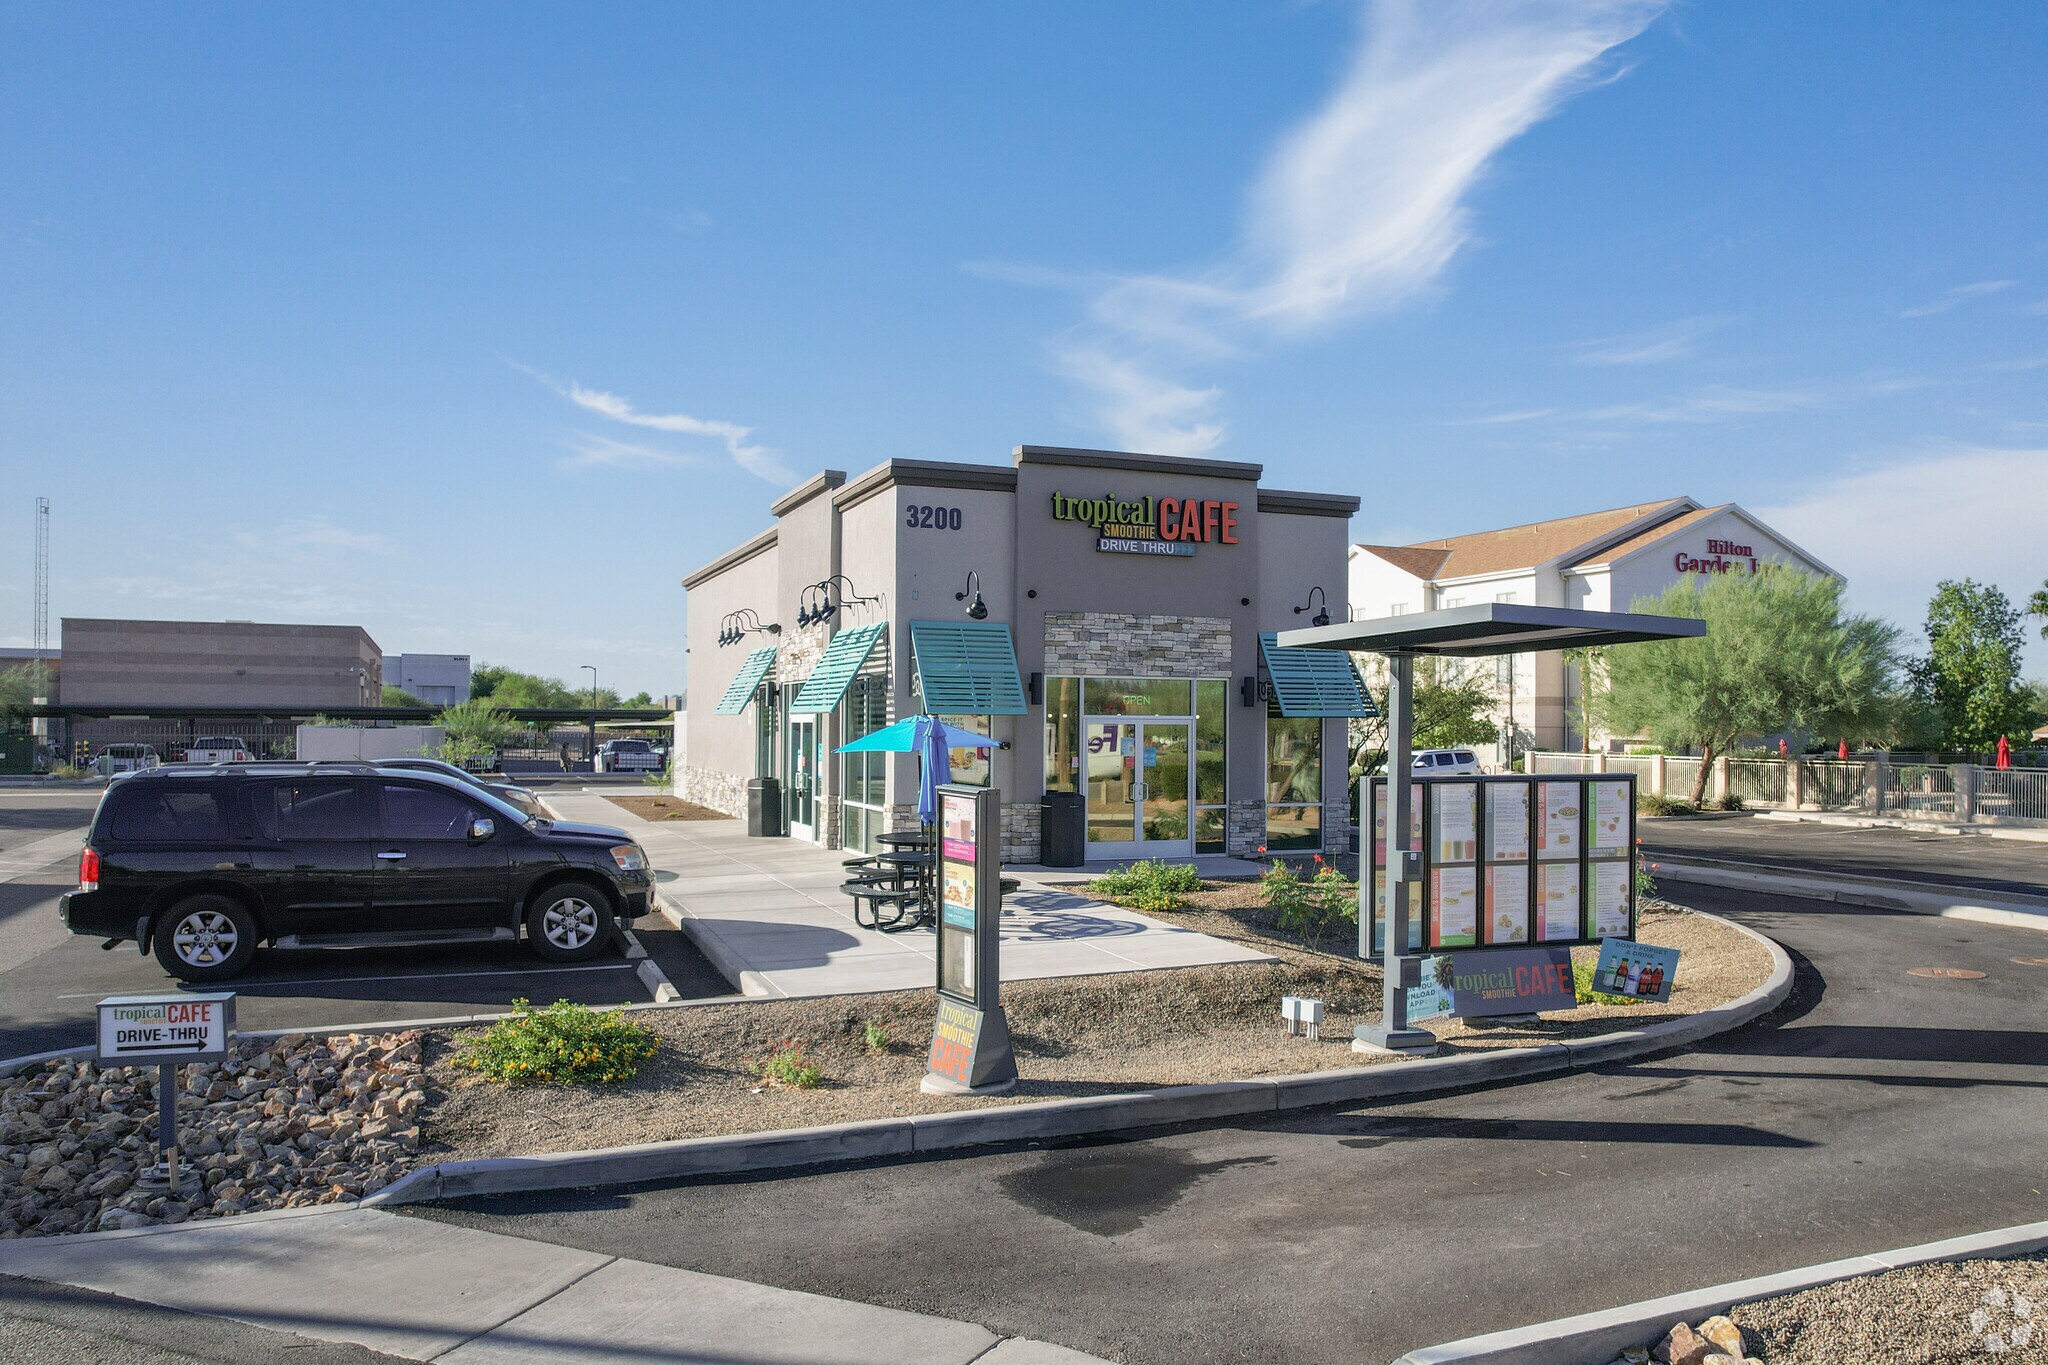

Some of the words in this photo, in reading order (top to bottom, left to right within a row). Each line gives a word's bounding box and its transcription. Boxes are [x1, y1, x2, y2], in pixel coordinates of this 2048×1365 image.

[906, 505, 962, 531] 3200
[1052, 490, 1155, 528] tropical
[1159, 496, 1240, 544] CAFE
[1104, 524, 1155, 539] SMOOTHIE
[1101, 539, 1138, 552] DRIVE
[1142, 541, 1175, 554] THRU
[1707, 539, 1753, 556] Hilton
[1122, 695, 1151, 705] OPEN
[1615, 941, 1638, 950] DON'T
[1639, 944, 1668, 955] FORGET
[1632, 951, 1655, 959] DRINK
[1454, 966, 1516, 995] ropical
[1515, 963, 1573, 997] CAFE
[1481, 988, 1517, 1000] SMOOTHIE
[1409, 999, 1425, 1008] APP
[113, 1005, 166, 1022] tropical
[167, 1003, 211, 1024] CAFE
[940, 1002, 979, 1031] tropical
[117, 1026, 208, 1043] DRIVE-THRU
[937, 1021, 975, 1049] SMOOTHIE
[931, 1037, 973, 1082] CAFE
